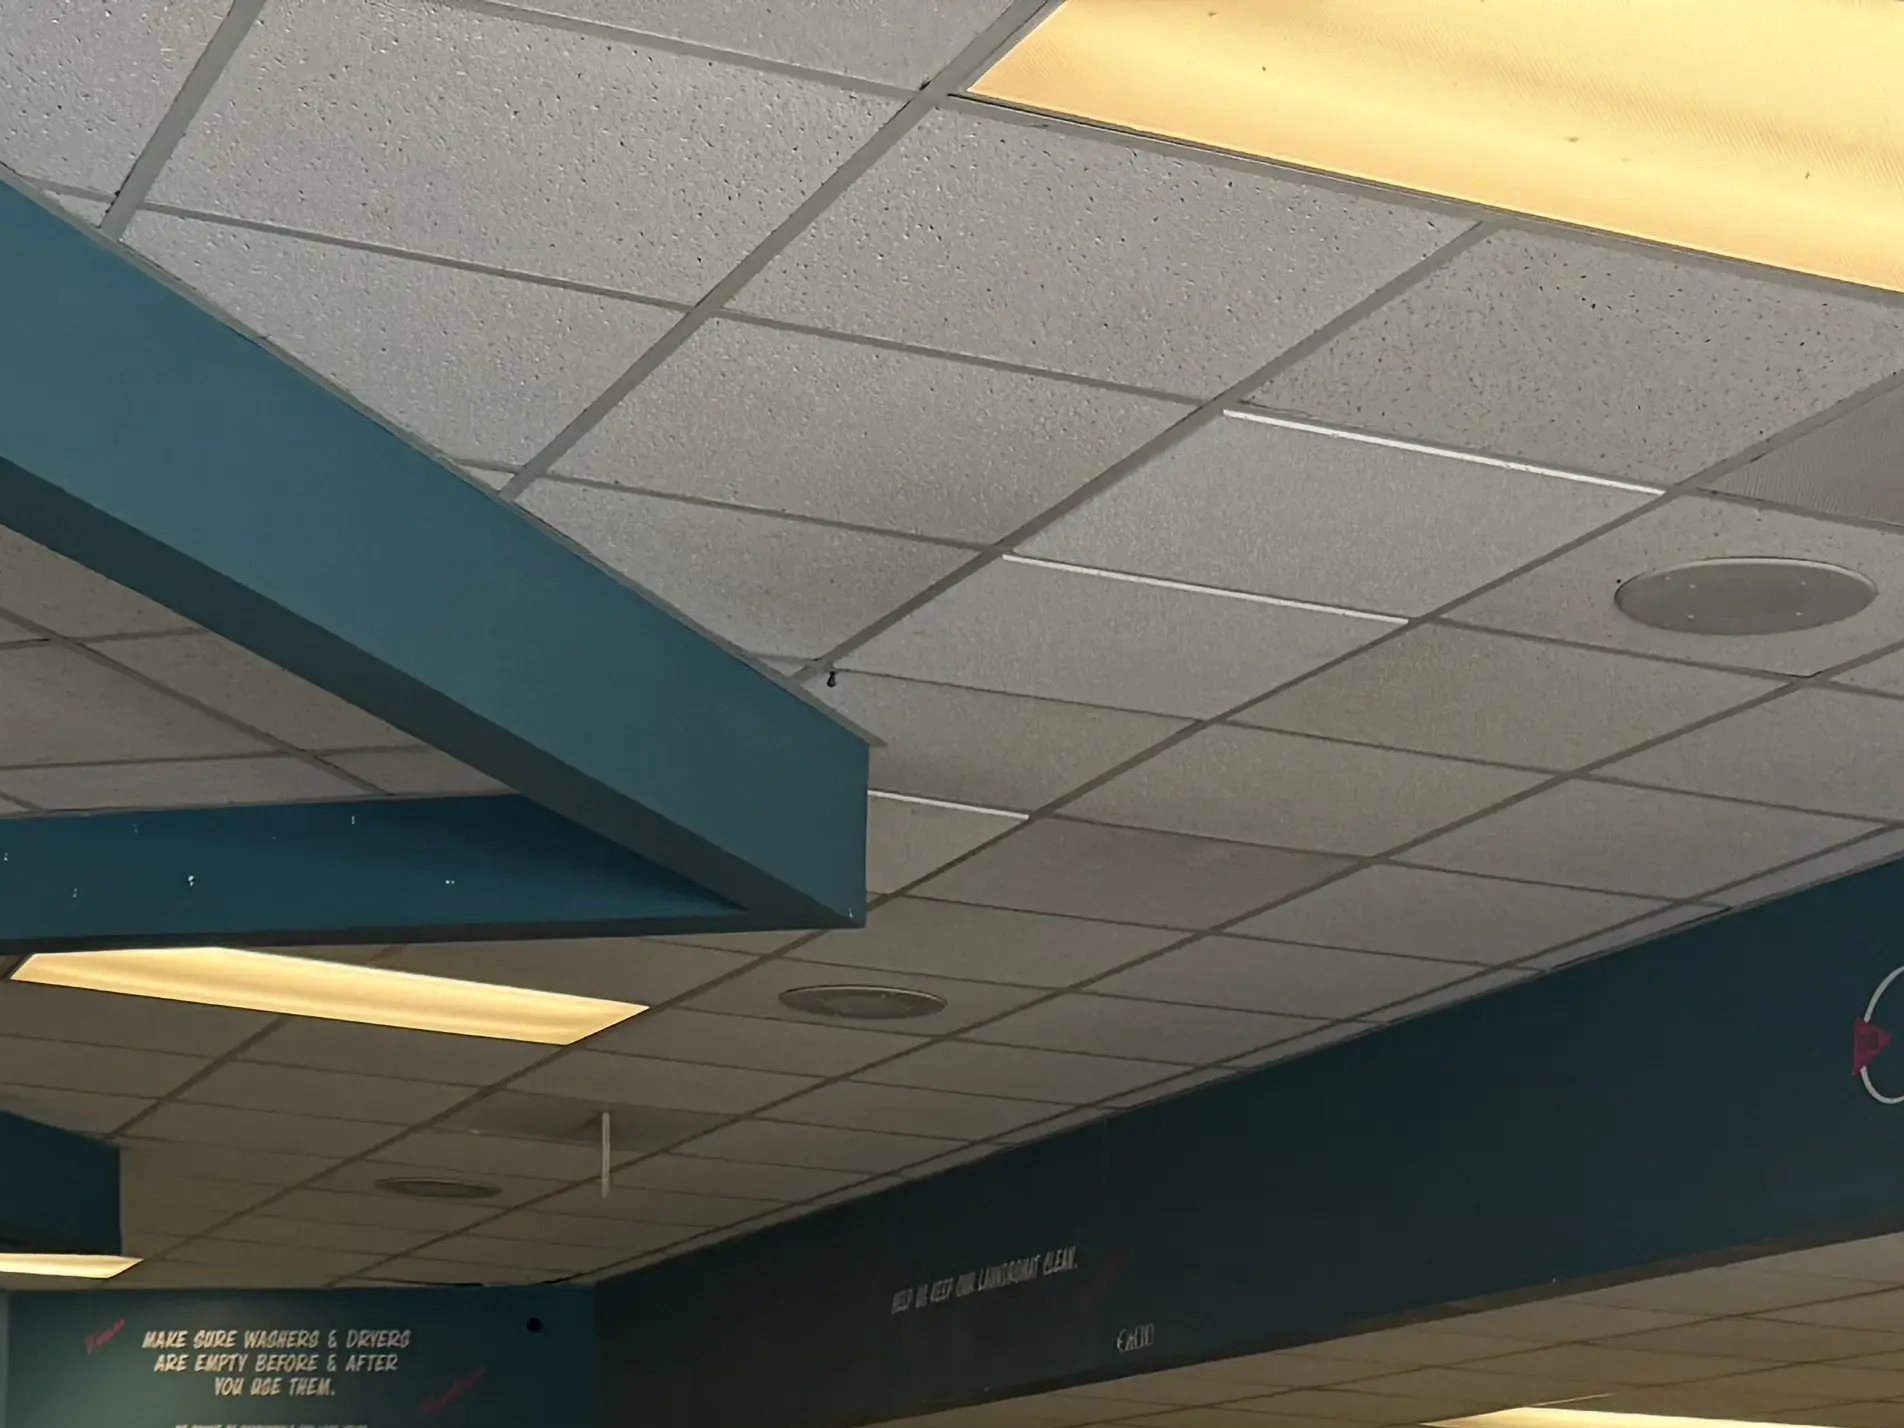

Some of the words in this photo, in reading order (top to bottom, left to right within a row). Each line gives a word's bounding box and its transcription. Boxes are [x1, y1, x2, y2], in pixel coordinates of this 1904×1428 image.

[1042, 1245, 1078, 1276] CLEAN.
[141, 1329, 189, 1349] MAKE
[193, 1329, 237, 1349] SURE
[243, 1329, 321, 1349] WASHERS
[327, 1329, 338, 1349] &
[345, 1328, 412, 1349] DRYERS
[153, 1353, 189, 1373] ARE
[195, 1353, 248, 1373] EMPTY
[254, 1353, 320, 1373] BEFORE
[326, 1353, 337, 1373] &
[344, 1353, 399, 1373] AFTER
[214, 1376, 245, 1396] YOU
[249, 1376, 283, 1396] USE
[288, 1377, 336, 1397] THEM.
